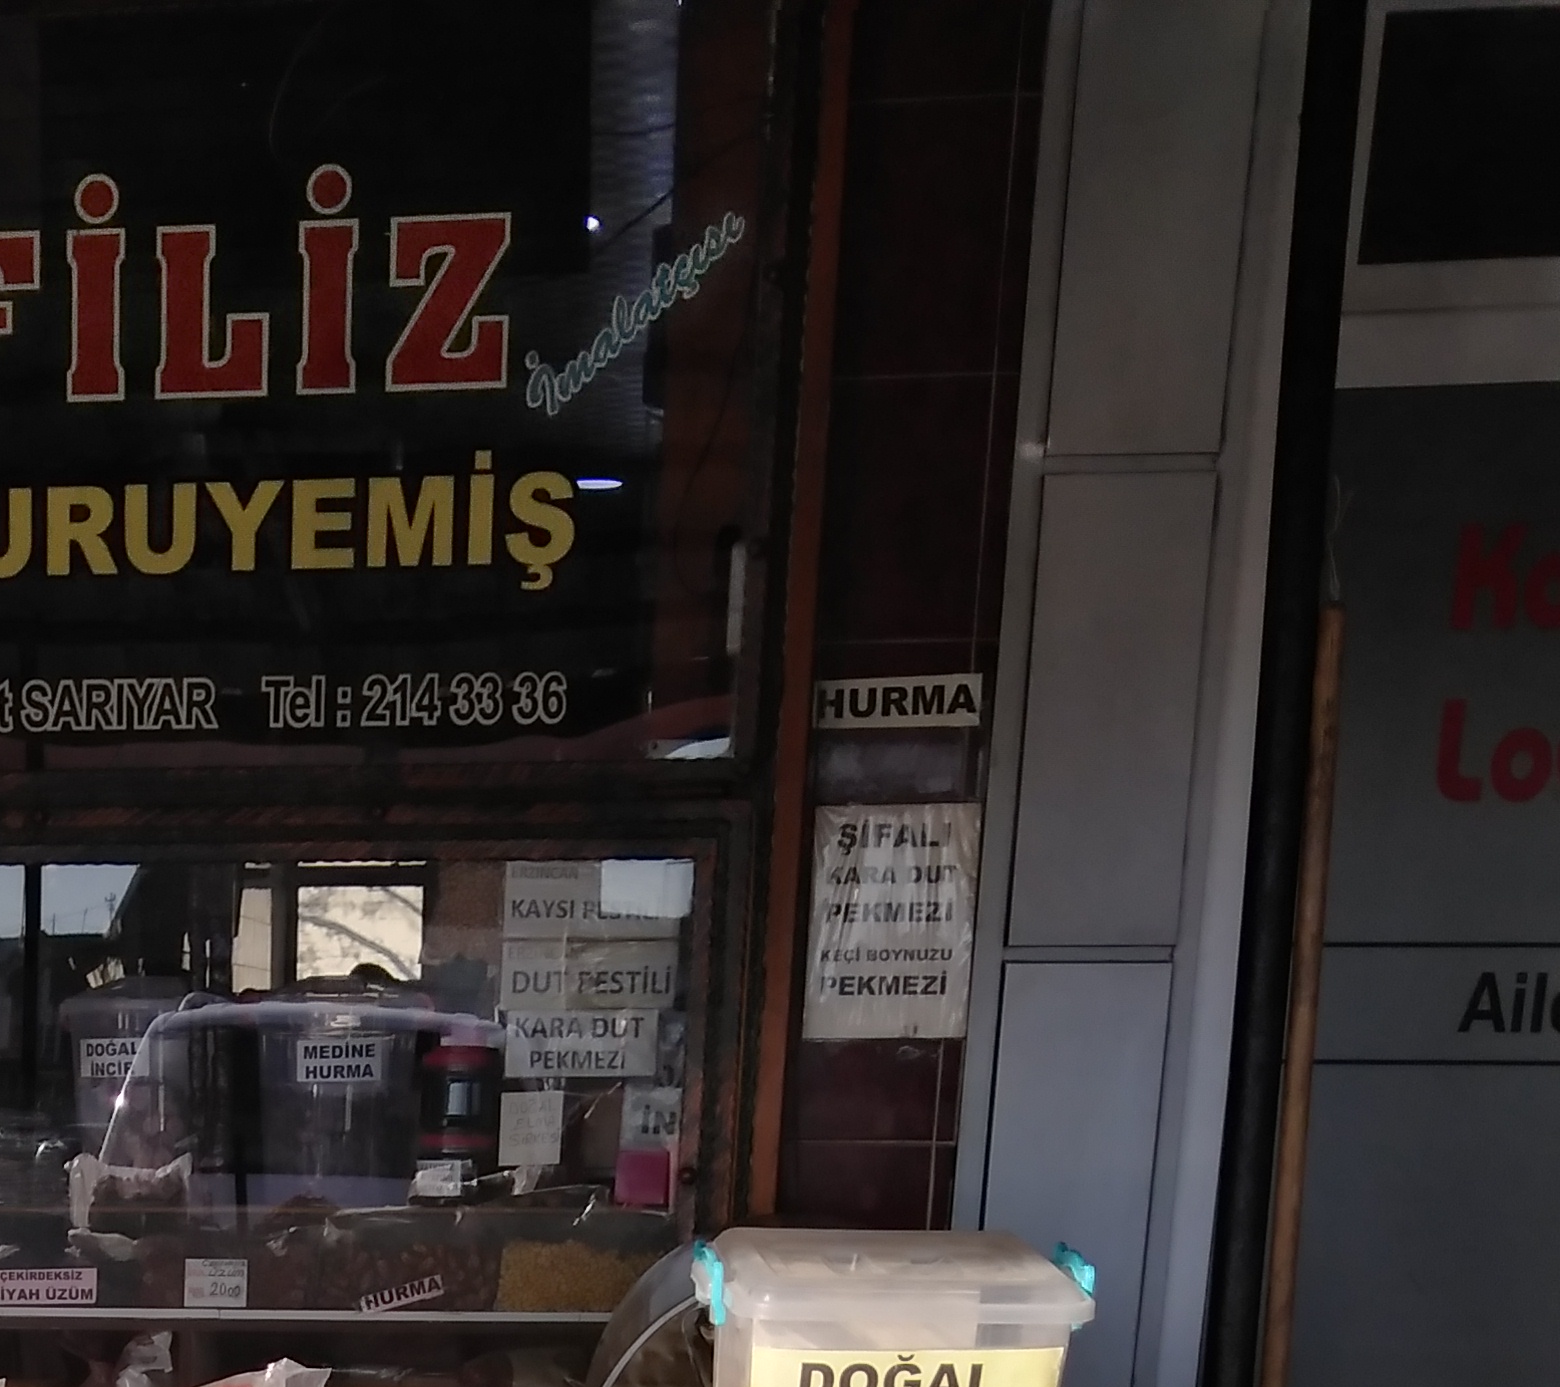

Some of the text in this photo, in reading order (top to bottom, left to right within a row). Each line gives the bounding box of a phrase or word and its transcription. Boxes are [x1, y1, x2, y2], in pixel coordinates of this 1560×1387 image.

[525, 211, 746, 416] İmalatçısı
[19, 676, 219, 732] SARIYAR
[261, 674, 325, 728] Tel
[359, 673, 442, 726] 214
[447, 672, 506, 724] 33
[510, 670, 569, 724] 36
[817, 683, 978, 719] HURMA
[511, 899, 574, 919] KAYSI
[866, 947, 953, 961] BOYNUZU
[820, 969, 947, 996] PEKMEZİ
[515, 1017, 644, 1038] KARA DUT
[303, 1041, 376, 1060] MEDİNE
[305, 1063, 373, 1079] HURMA
[0, 1270, 82, 1283] ÇEKİRDEKSİZ
[45, 1286, 93, 1301] ÜZÜM
[364, 1277, 441, 1310] HURMA
